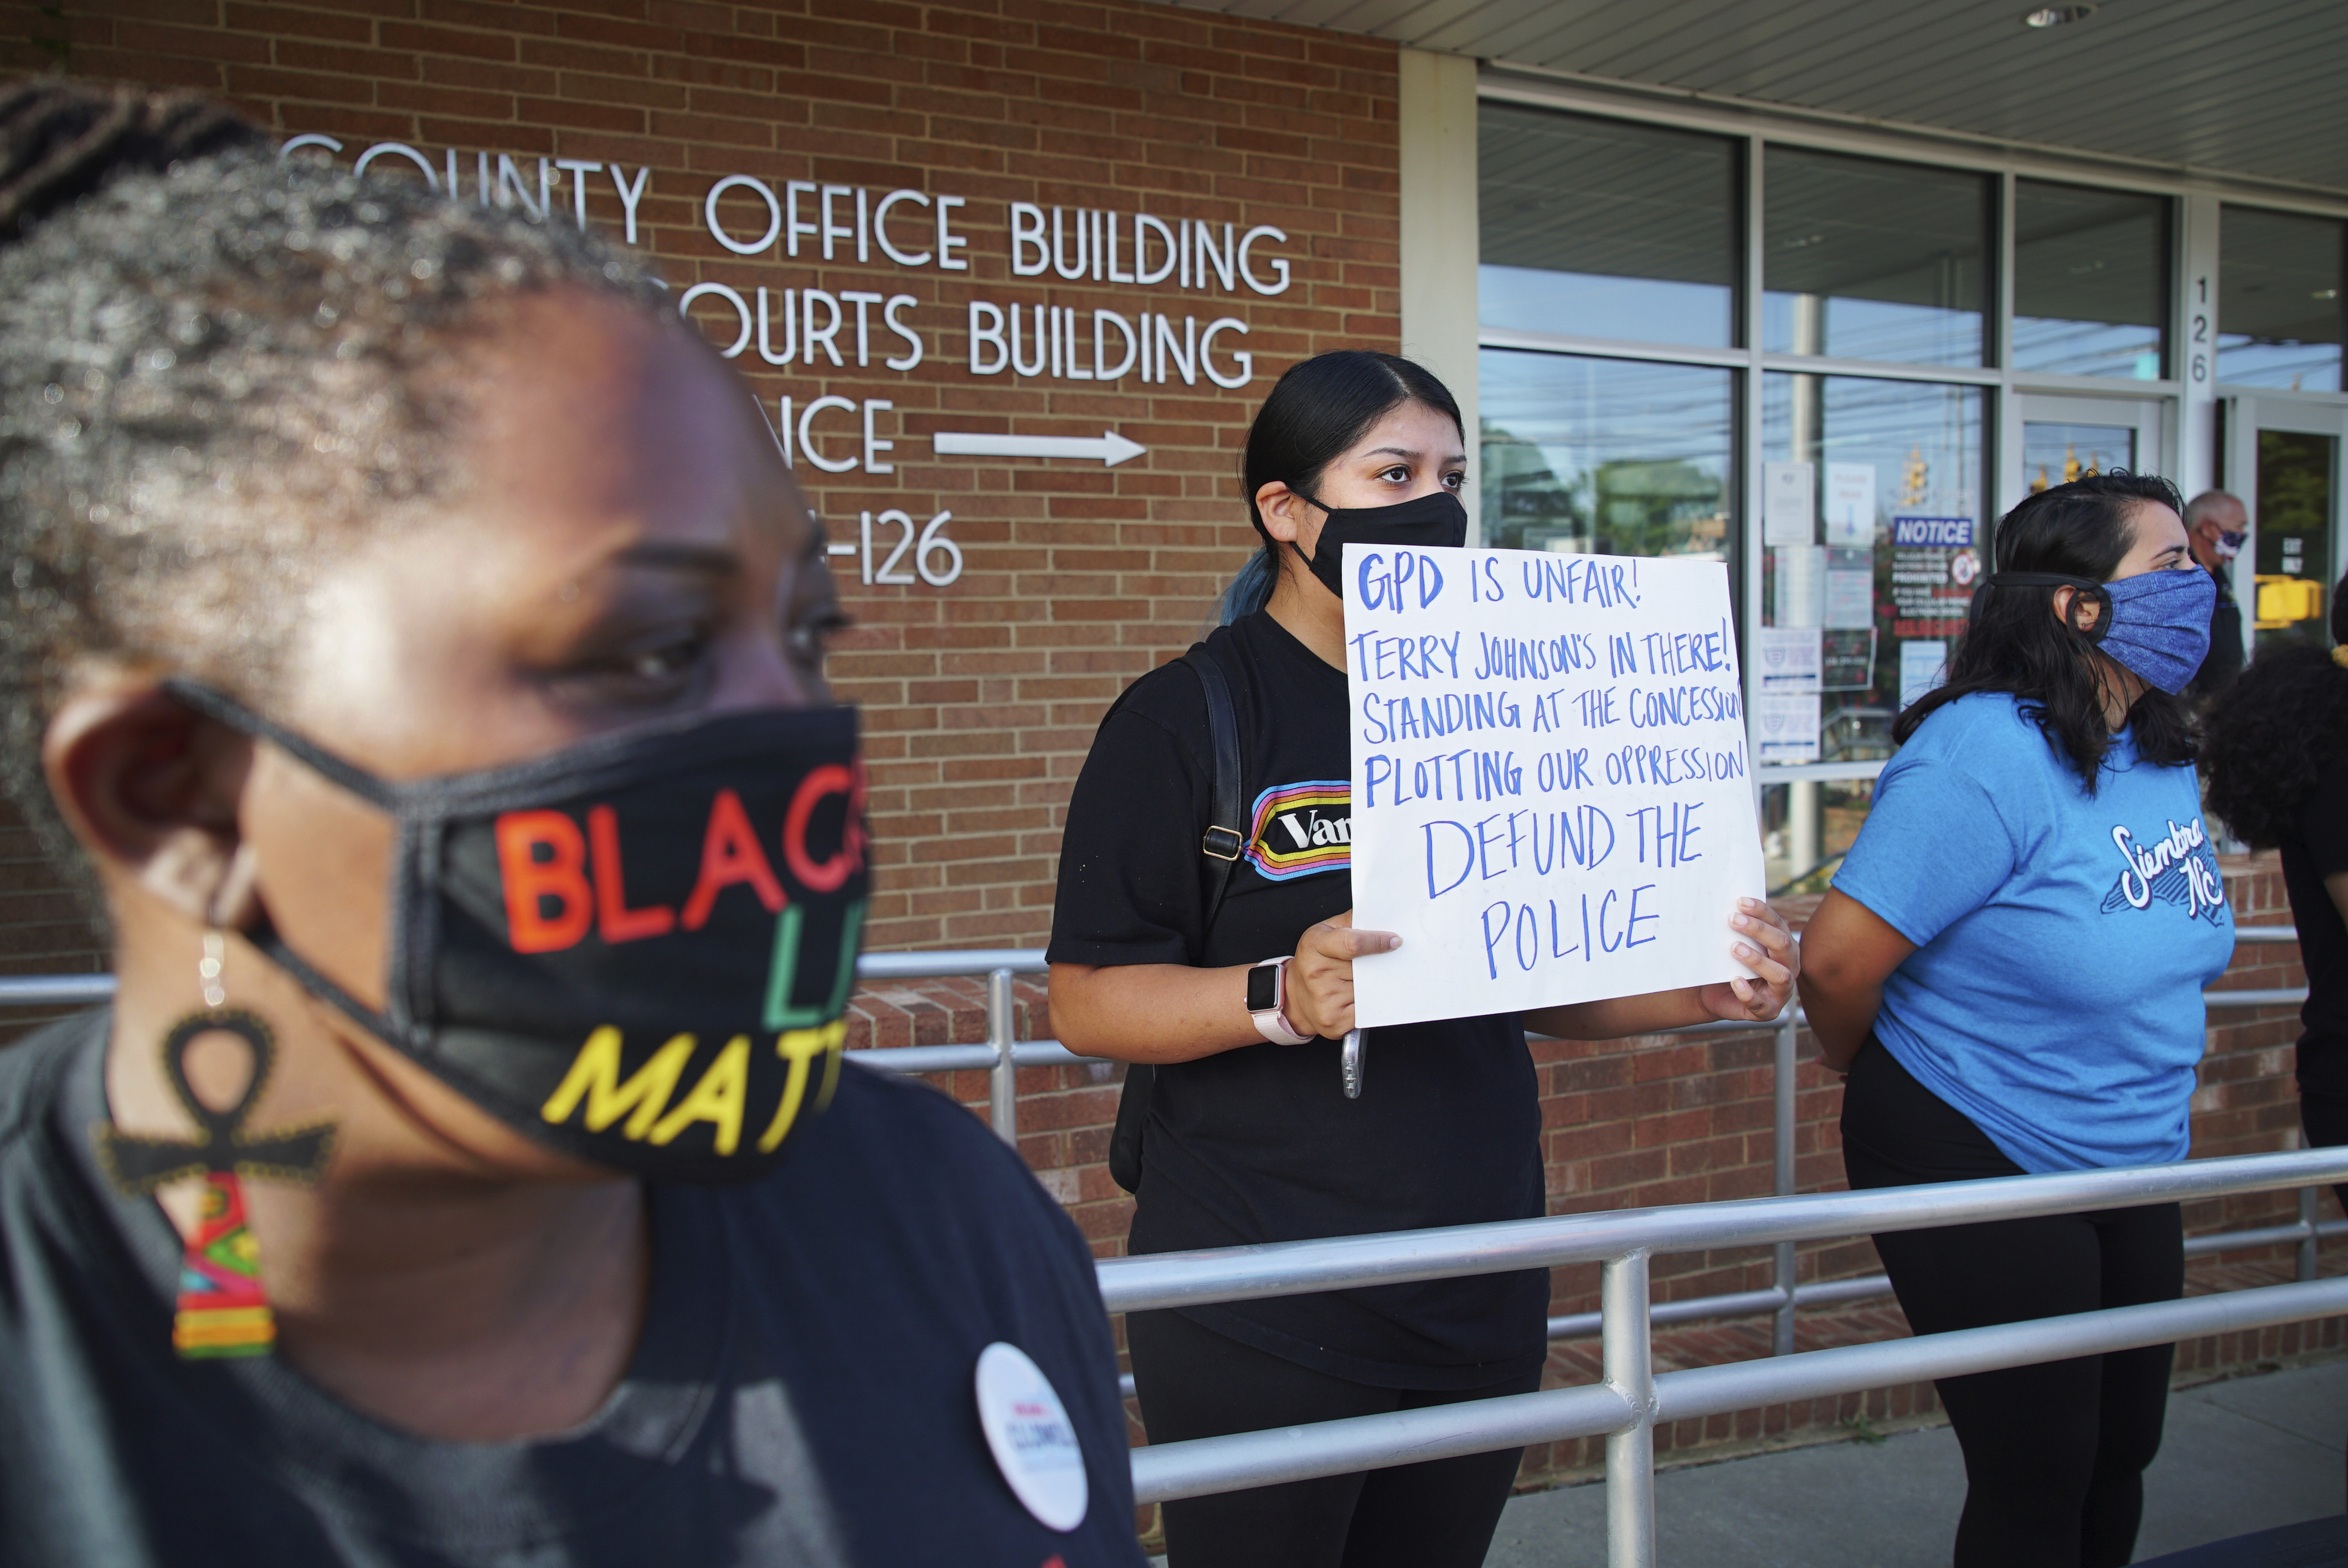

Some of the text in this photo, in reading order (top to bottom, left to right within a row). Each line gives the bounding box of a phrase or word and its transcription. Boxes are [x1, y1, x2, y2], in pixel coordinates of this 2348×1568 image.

[705, 173, 968, 270] OFFICE
[1010, 201, 1290, 296] BUILDING
[642, 276, 1253, 389] OURTS BUILDING
[2192, 276, 2207, 382] 126
[807, 508, 964, 587] -126
[1896, 519, 1971, 544] NOTICE
[1358, 551, 1641, 613] GPD IS UNFAIR!
[1349, 630, 1460, 681] TERRY
[1474, 631, 1597, 680] JOHNSON'S
[1609, 632, 1636, 678] IN
[1640, 616, 1731, 676] THERE!
[1363, 692, 1521, 745] STANDING
[1532, 688, 1566, 733] AT
[1572, 687, 1621, 728] THE
[1629, 676, 1742, 729] CONCESSION
[1365, 740, 1743, 808] PLOTTING OUR OPPRESSION
[1419, 802, 1704, 899] DEFUND THE
[2112, 817, 2204, 908] Siembra
[1481, 884, 1660, 979] POLICE
